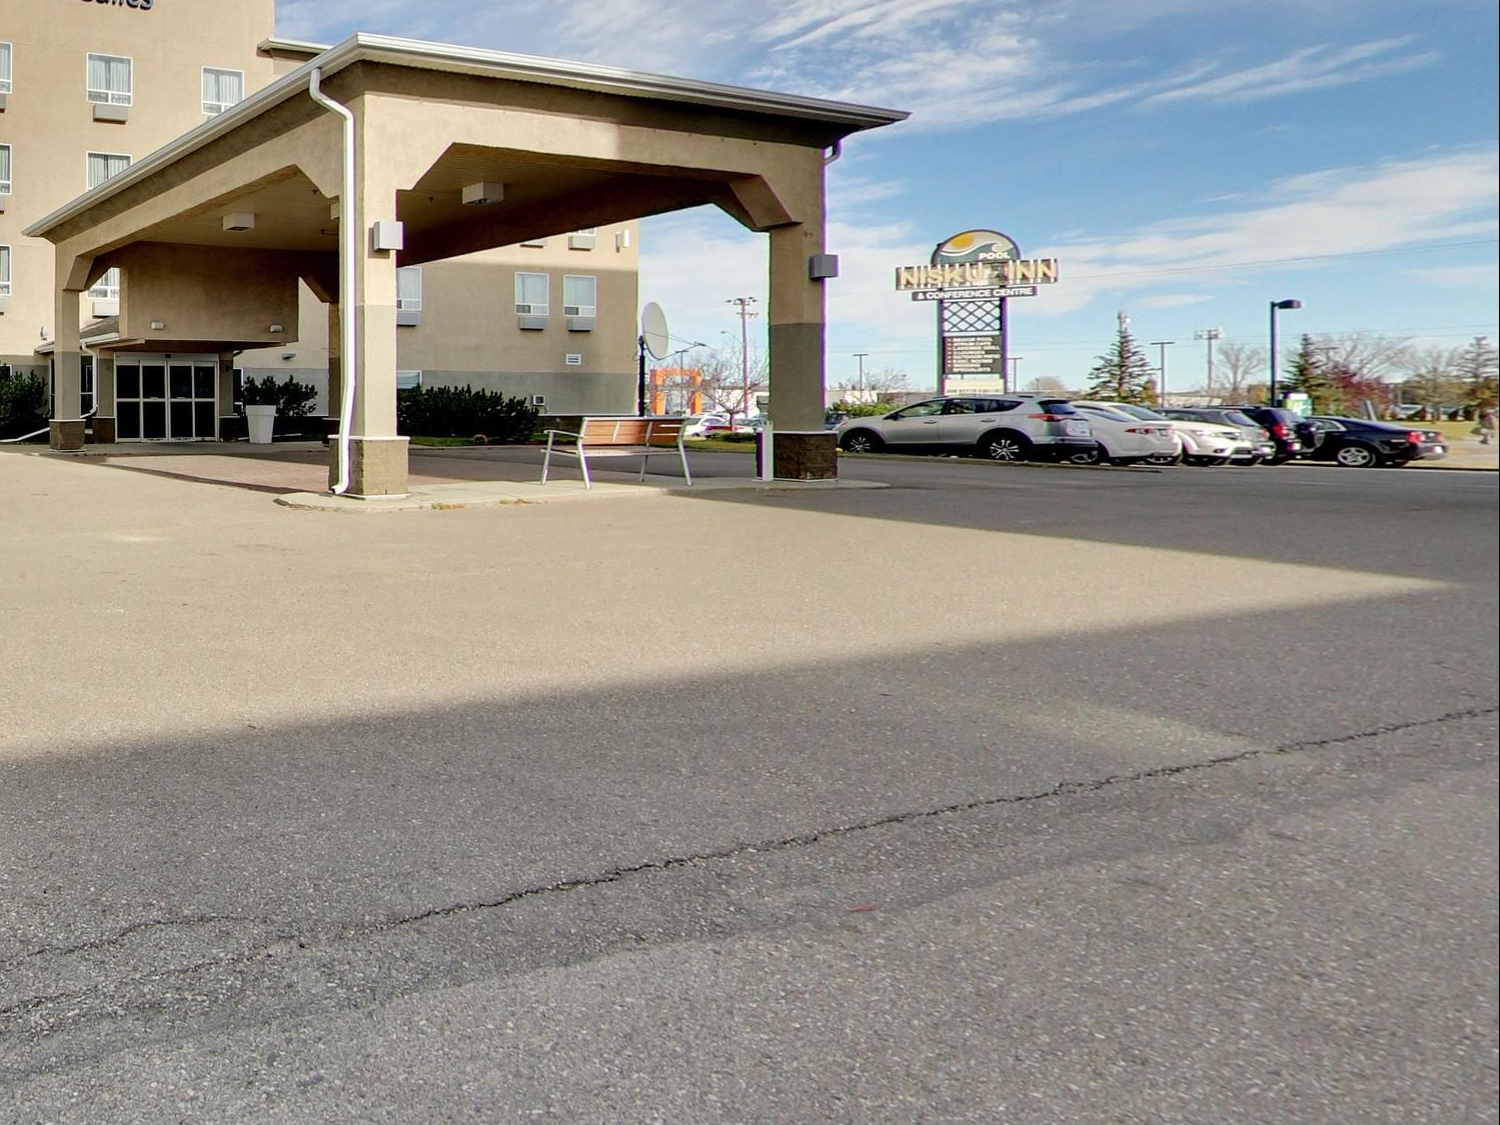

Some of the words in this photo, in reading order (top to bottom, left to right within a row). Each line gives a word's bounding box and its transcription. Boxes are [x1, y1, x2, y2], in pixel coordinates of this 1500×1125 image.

[979, 251, 1011, 260] POOL
[900, 264, 985, 286] NISKU
[1007, 259, 1057, 280] INN
[926, 289, 991, 300] CONFERENCE
[992, 286, 1033, 297] CENTRE
